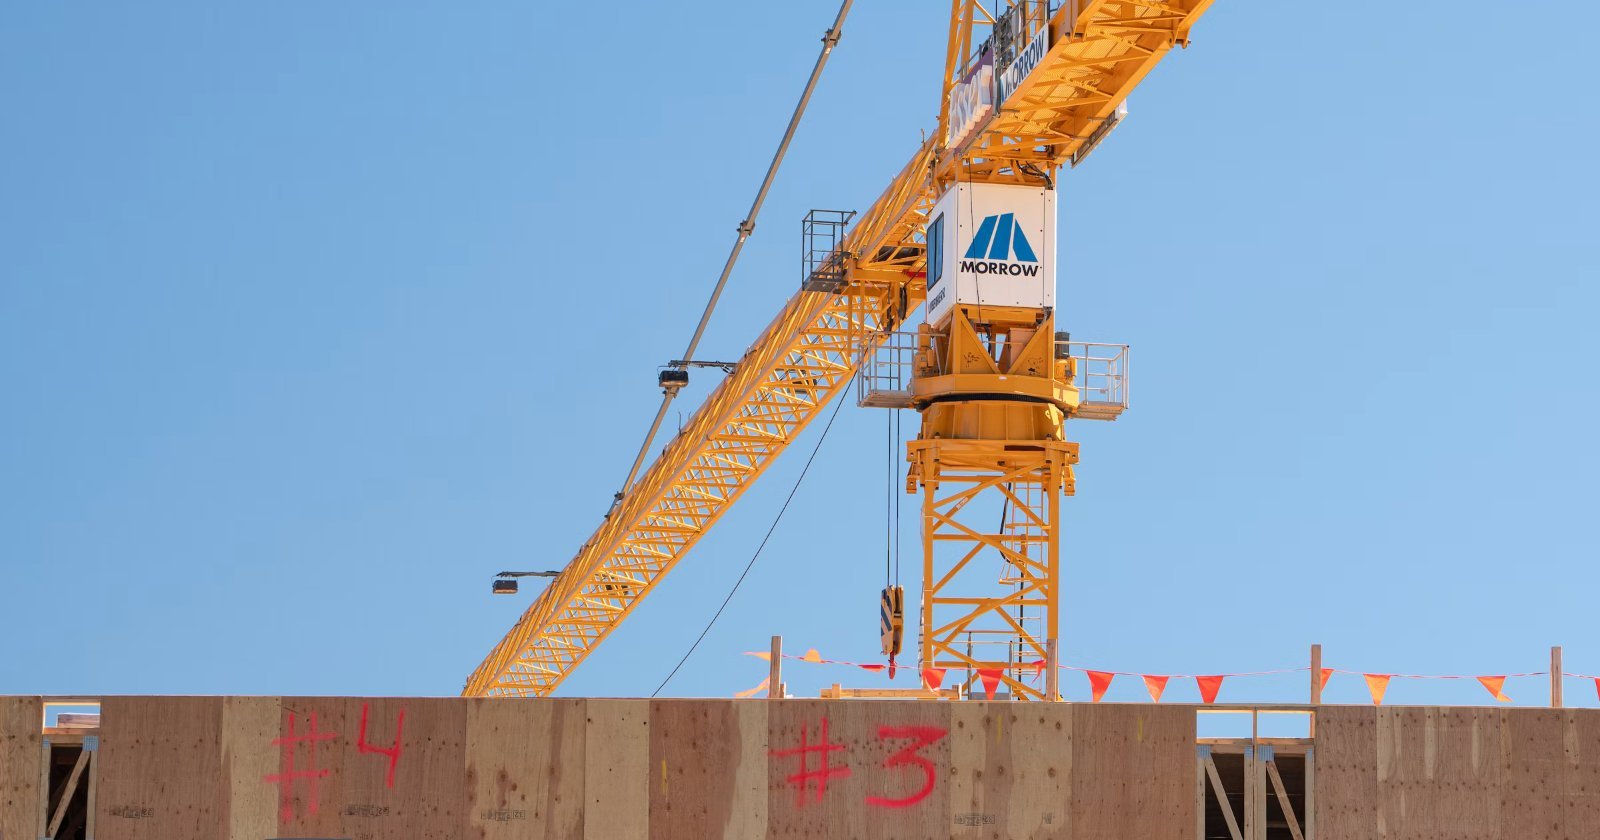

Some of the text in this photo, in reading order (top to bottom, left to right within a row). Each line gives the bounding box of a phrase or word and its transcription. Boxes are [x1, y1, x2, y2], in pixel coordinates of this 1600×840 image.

[1005, 30, 1045, 98] MORROW
[960, 260, 1039, 277] MORROW
[264, 703, 405, 822] #4
[768, 716, 948, 809] #3
